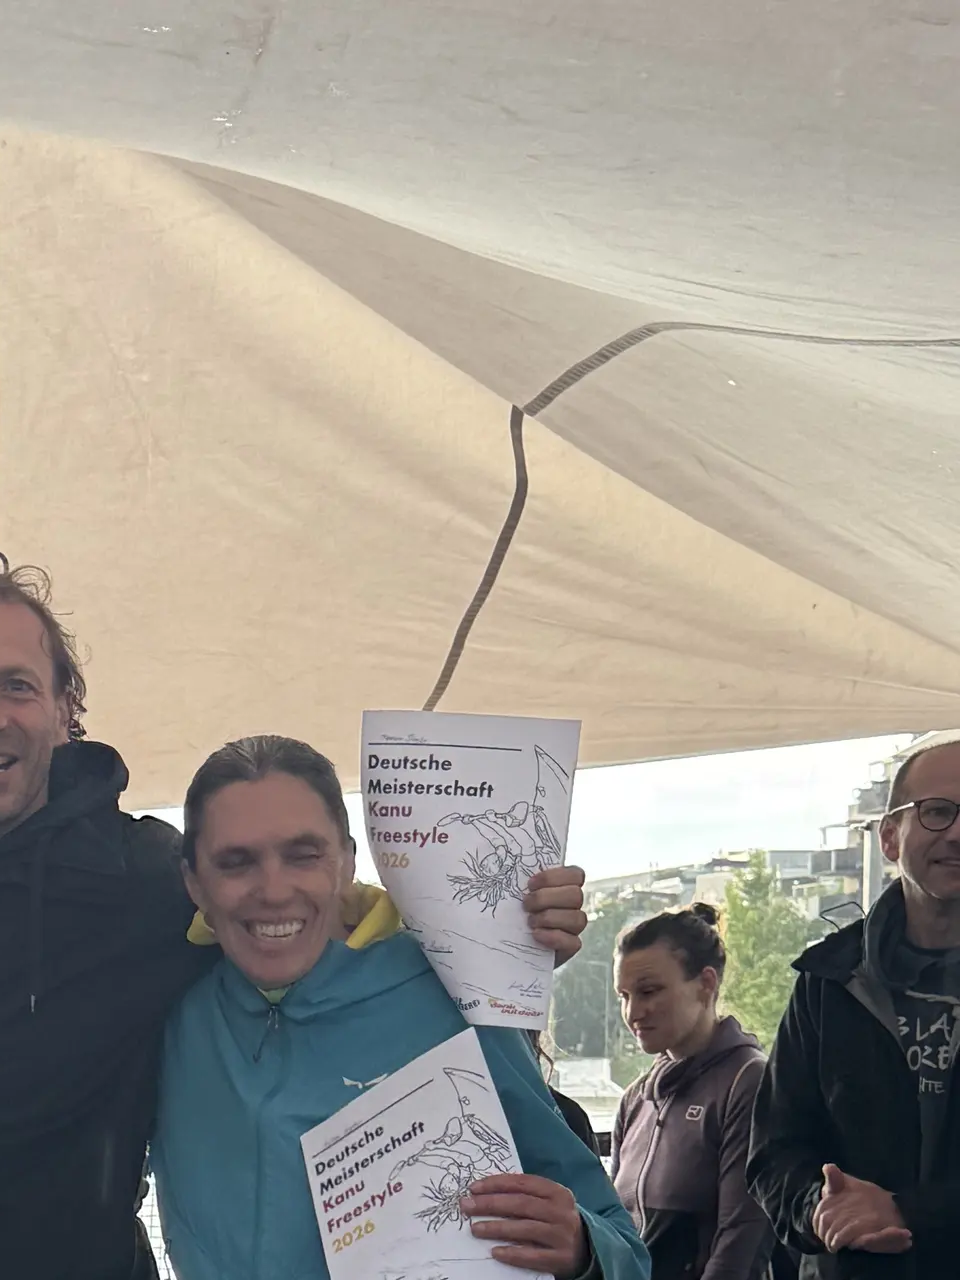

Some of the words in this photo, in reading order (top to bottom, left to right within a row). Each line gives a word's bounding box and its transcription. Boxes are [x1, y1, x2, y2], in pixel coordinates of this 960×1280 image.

[367, 754, 452, 772] Deutsche
[367, 780, 494, 799] Meisterschaft
[368, 802, 412, 818] Kanu
[370, 826, 449, 847] Freestyle
[314, 1124, 385, 1176] Deutsche
[319, 1120, 425, 1196] Meisterschaft
[323, 1180, 365, 1213] Kanu
[327, 1179, 404, 1234] Freestyle
[331, 1219, 376, 1254] 2026
